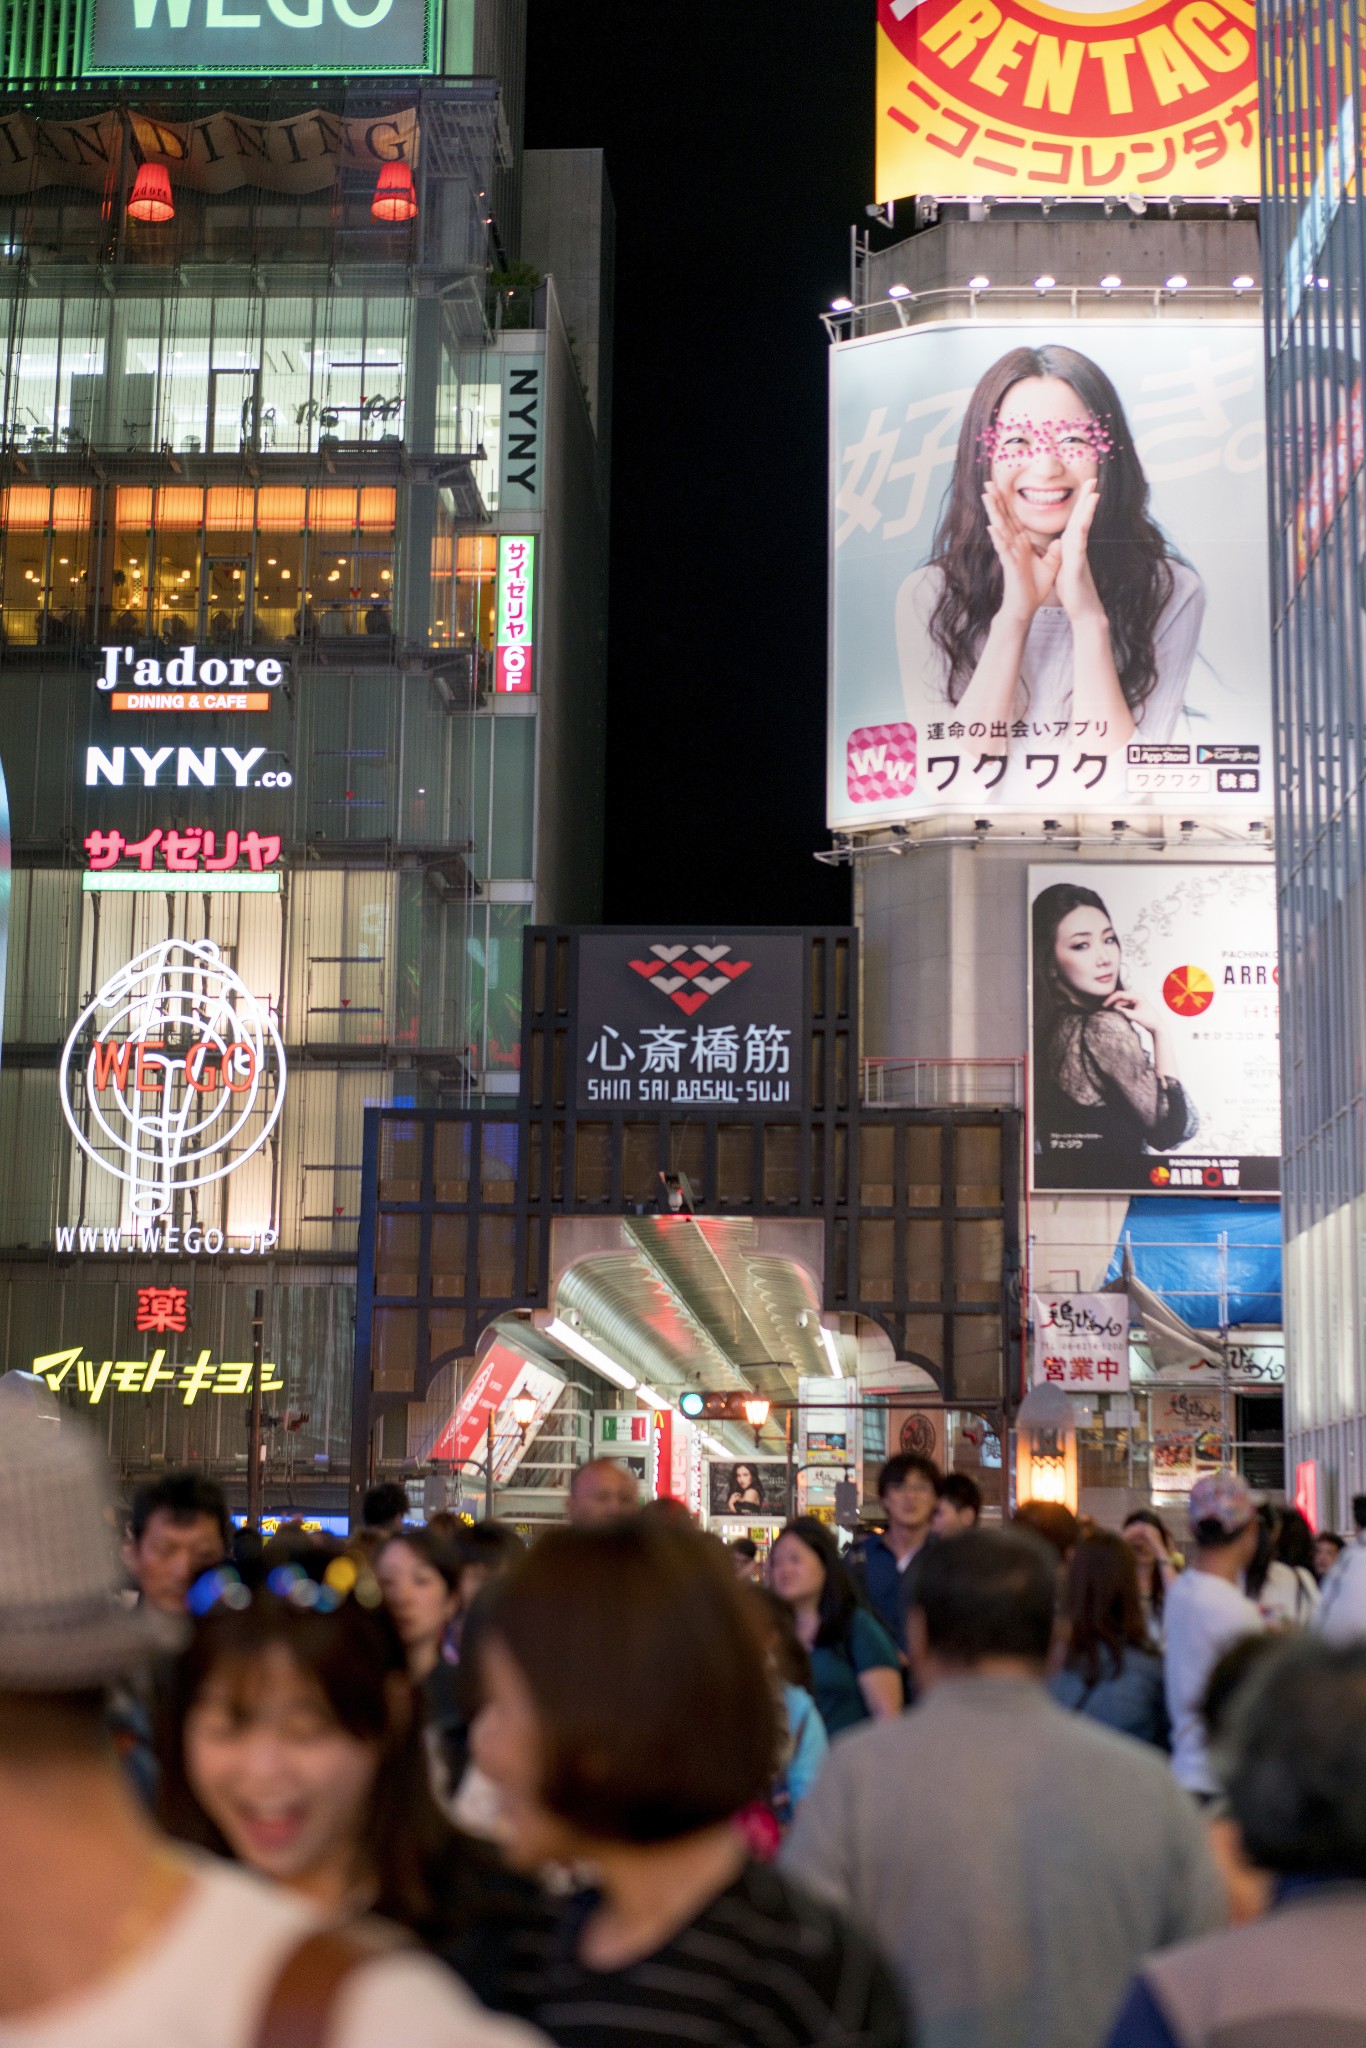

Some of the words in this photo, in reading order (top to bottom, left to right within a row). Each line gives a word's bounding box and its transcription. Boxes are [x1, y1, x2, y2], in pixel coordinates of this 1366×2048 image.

[919, 0, 1256, 115] RENTAC
[507, 369, 539, 494] NYNY
[506, 543, 526, 639] サイゼリヤ
[97, 646, 283, 690] J'adore
[503, 646, 525, 691] 6F
[127, 695, 185, 709] DINING
[188, 695, 200, 709] &
[204, 695, 247, 709] CAFE
[926, 719, 1109, 740] 運命の出会いアプリ
[928, 753, 1108, 791] ワクワク
[1136, 774, 1201, 787] ワクワク
[84, 828, 281, 871] サイゼリヤ
[587, 1024, 791, 1074] 心斎橋筋
[588, 1079, 630, 1100] SHIN
[638, 1080, 669, 1101] SAI
[1170, 1167, 1240, 1188] ARROW
[55, 1227, 277, 1254] WWW.WEGO.JP
[136, 1286, 188, 1333] 薬
[33, 1347, 284, 1406] マツモトキヨシ
[1042, 1357, 1119, 1382] 営業中
